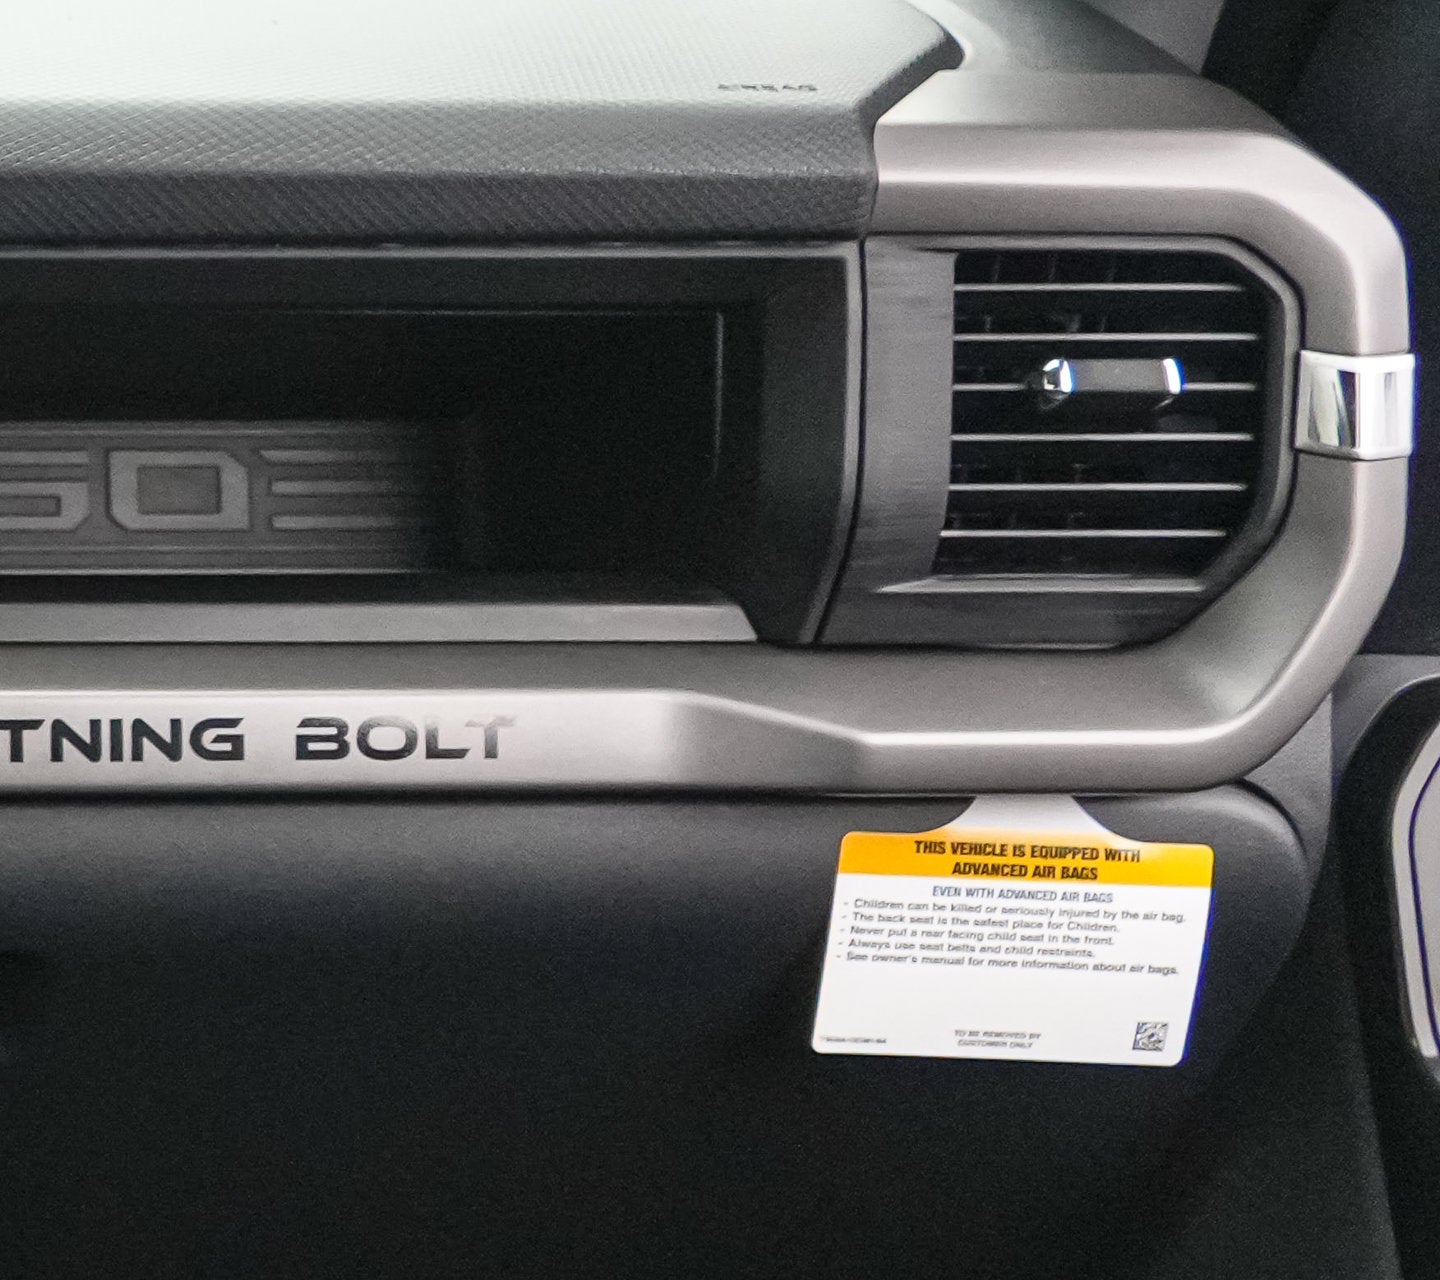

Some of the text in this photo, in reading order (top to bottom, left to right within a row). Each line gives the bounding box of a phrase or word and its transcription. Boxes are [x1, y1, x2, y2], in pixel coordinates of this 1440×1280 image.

[296, 715, 516, 763] BOLT
[915, 840, 1141, 863] THIS VEHICLE IS EQUIPPED WITH
[952, 862, 1098, 880] ADVANCED AIR BAGS
[932, 885, 1114, 903] EVEN WITH ADVANCED AIR BAGS
[854, 898, 904, 910] Children
[907, 902, 929, 911] can
[932, 901, 947, 911] be
[950, 902, 981, 913] killed
[984, 906, 998, 914] or
[1001, 905, 1055, 918] seriously
[1059, 907, 1100, 920] injured
[1103, 910, 1117, 921] by
[1121, 909, 1139, 920] the
[1142, 911, 1157, 920] air
[852, 911, 874, 922] The
[878, 912, 905, 923] back
[909, 914, 934, 924] seat
[951, 916, 969, 926] the
[972, 917, 1008, 928] safest
[1012, 919, 1043, 930] place
[1047, 920, 1064, 930] for
[850, 925, 883, 936] Never
[888, 927, 907, 939] put
[921, 929, 944, 938] rear
[948, 929, 984, 942] facing
[987, 931, 1016, 942] child
[1020, 933, 1044, 942] seat
[1048, 934, 1058, 943] in
[1062, 934, 1080, 944] the
[848, 938, 891, 951] Always
[894, 942, 916, 950] use
[919, 941, 944, 951] seat
[947, 943, 976, 953] belts
[979, 944, 1001, 954] and
[1004, 945, 1033, 955] child
[846, 951, 868, 961] See
[921, 955, 965, 966] manual
[968, 956, 984, 966] for
[987, 959, 1018, 968] more
[1021, 958, 1088, 971] information
[1092, 963, 1126, 973] about
[1129, 964, 1144, 973] air
